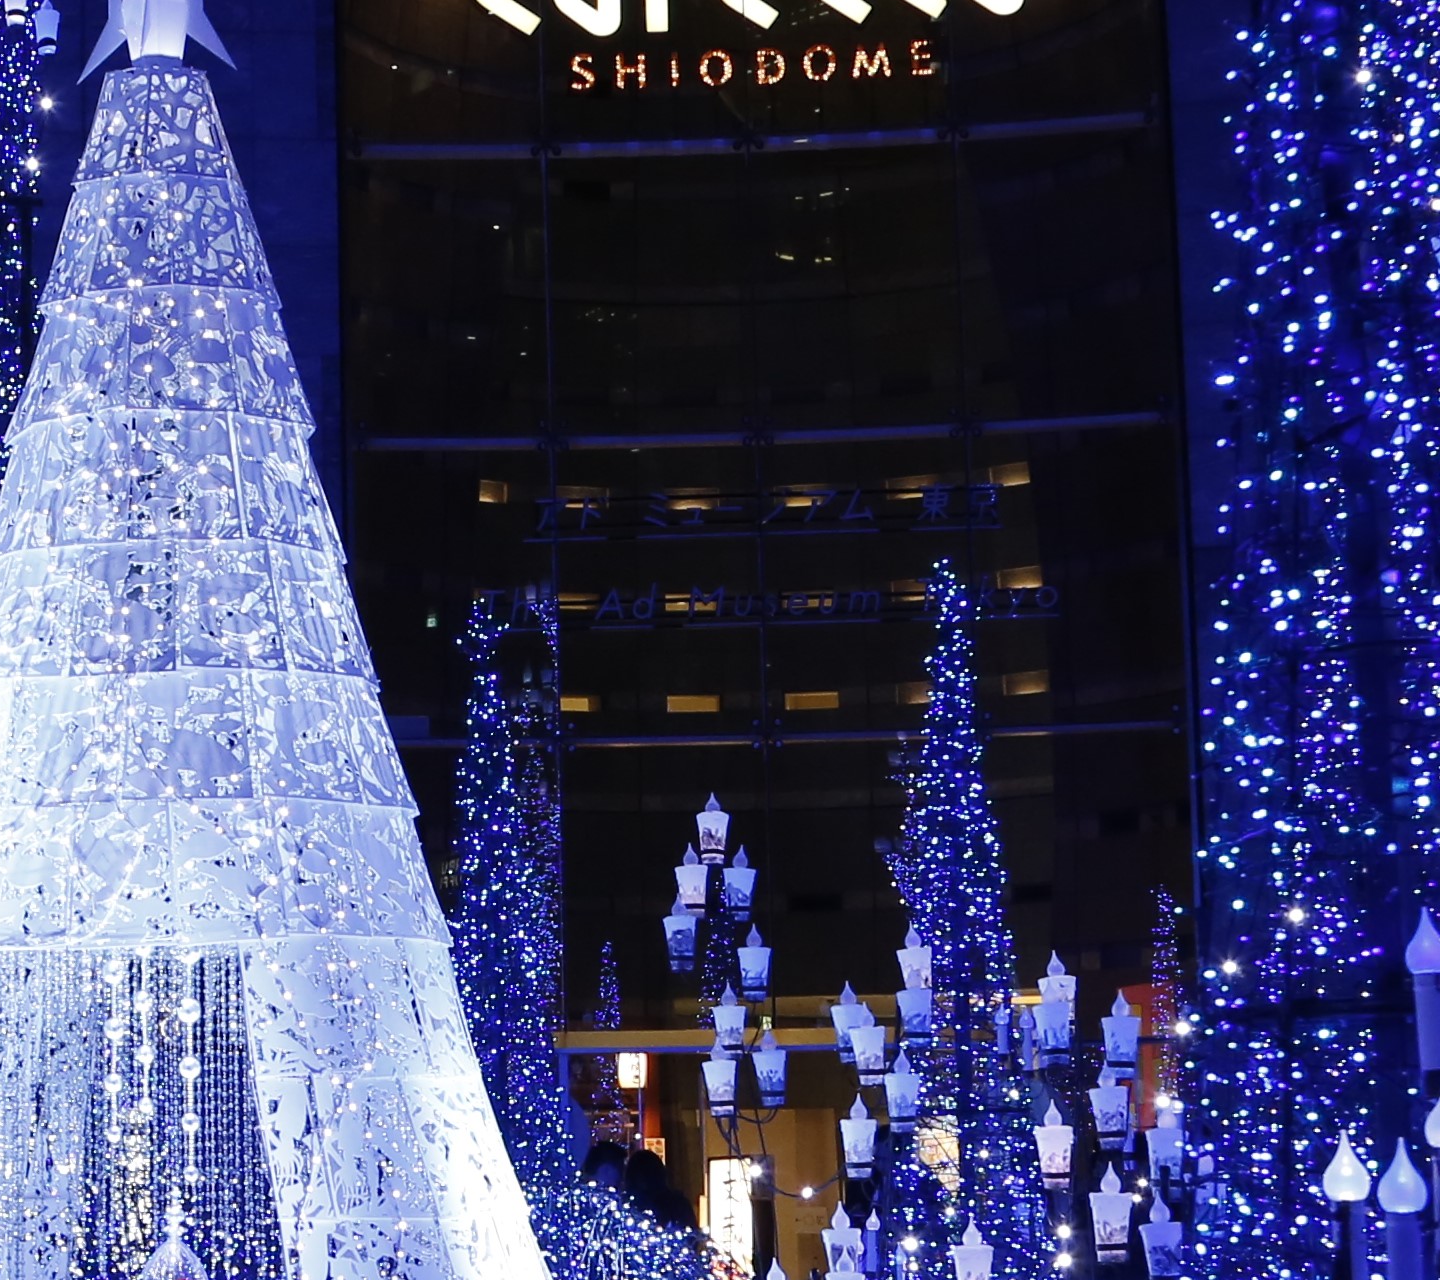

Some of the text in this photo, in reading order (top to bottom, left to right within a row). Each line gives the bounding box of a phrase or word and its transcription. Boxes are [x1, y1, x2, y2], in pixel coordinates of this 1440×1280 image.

[568, 38, 938, 93] SHIODOME
[480, 576, 1060, 625] Th Ad Museum Tkyo
